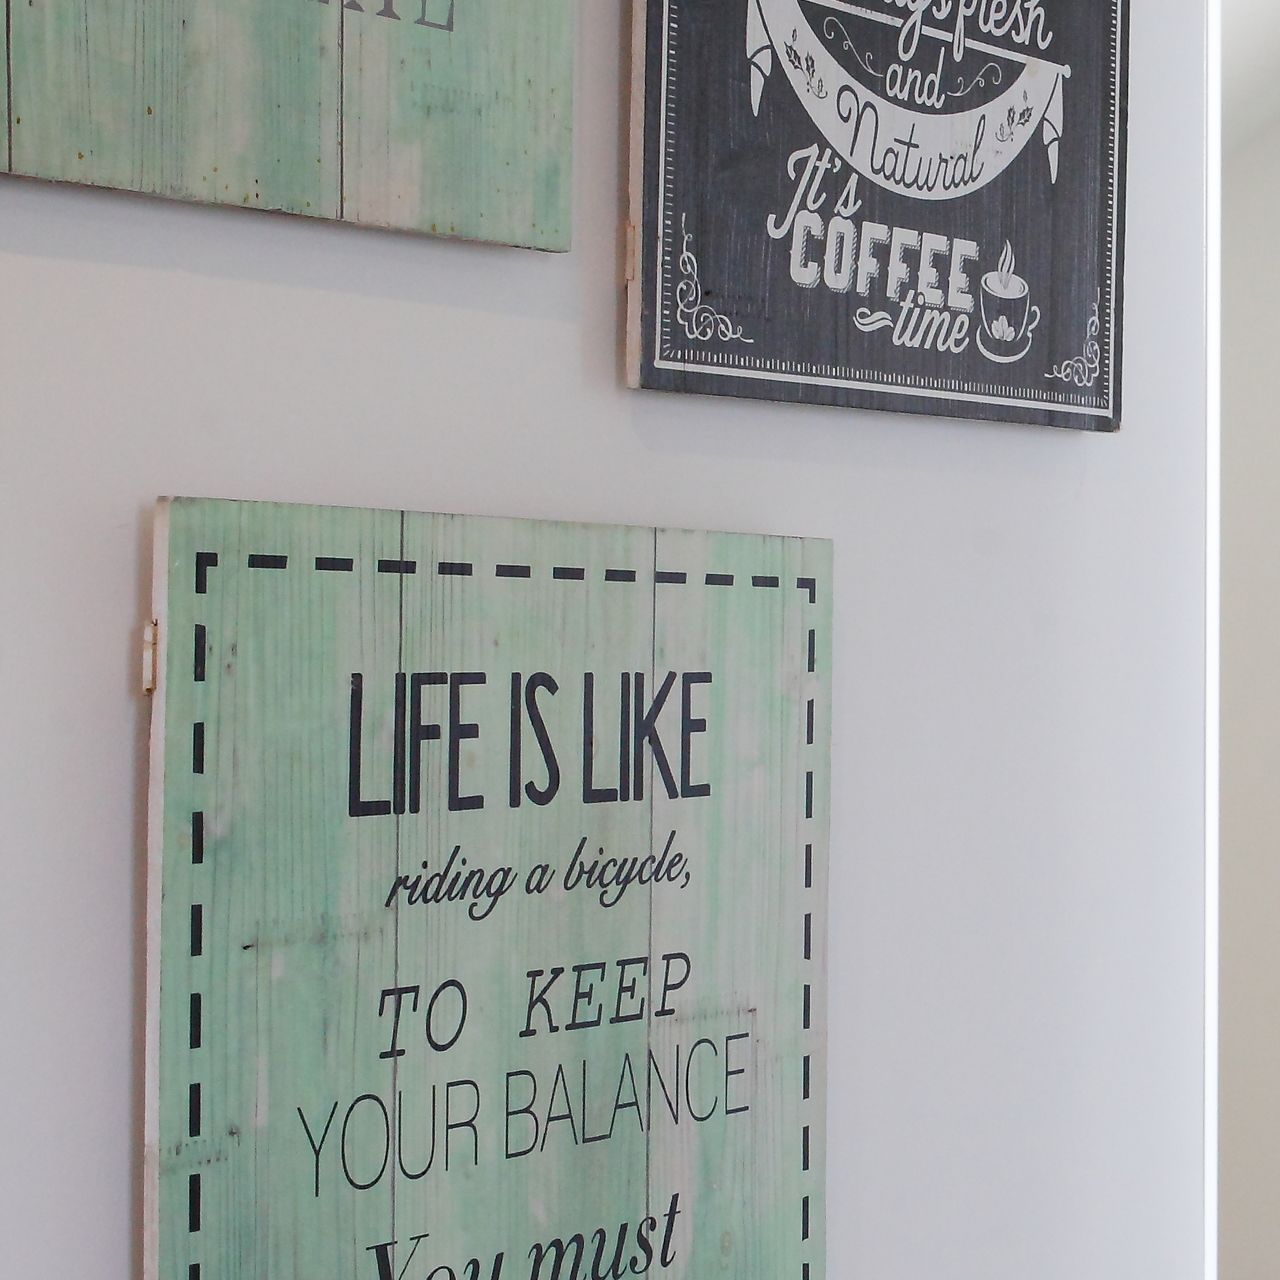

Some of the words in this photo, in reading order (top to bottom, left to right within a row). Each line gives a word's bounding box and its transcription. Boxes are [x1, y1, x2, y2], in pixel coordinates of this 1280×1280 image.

[884, 49, 947, 109] and
[836, 84, 989, 192] Natural
[767, 145, 862, 239] It's
[788, 209, 980, 310] COFFEE
[891, 289, 970, 351] time
[348, 672, 487, 818] LIFE
[509, 672, 561, 808] IS
[582, 671, 713, 804] LIKE
[385, 845, 518, 921] riding
[525, 864, 554, 894] a
[563, 830, 692, 908] bicycle,
[378, 979, 468, 1059] TO
[519, 952, 692, 1039] KEEP
[297, 1079, 479, 1198] YOUR
[505, 1032, 750, 1160] BALANCE
